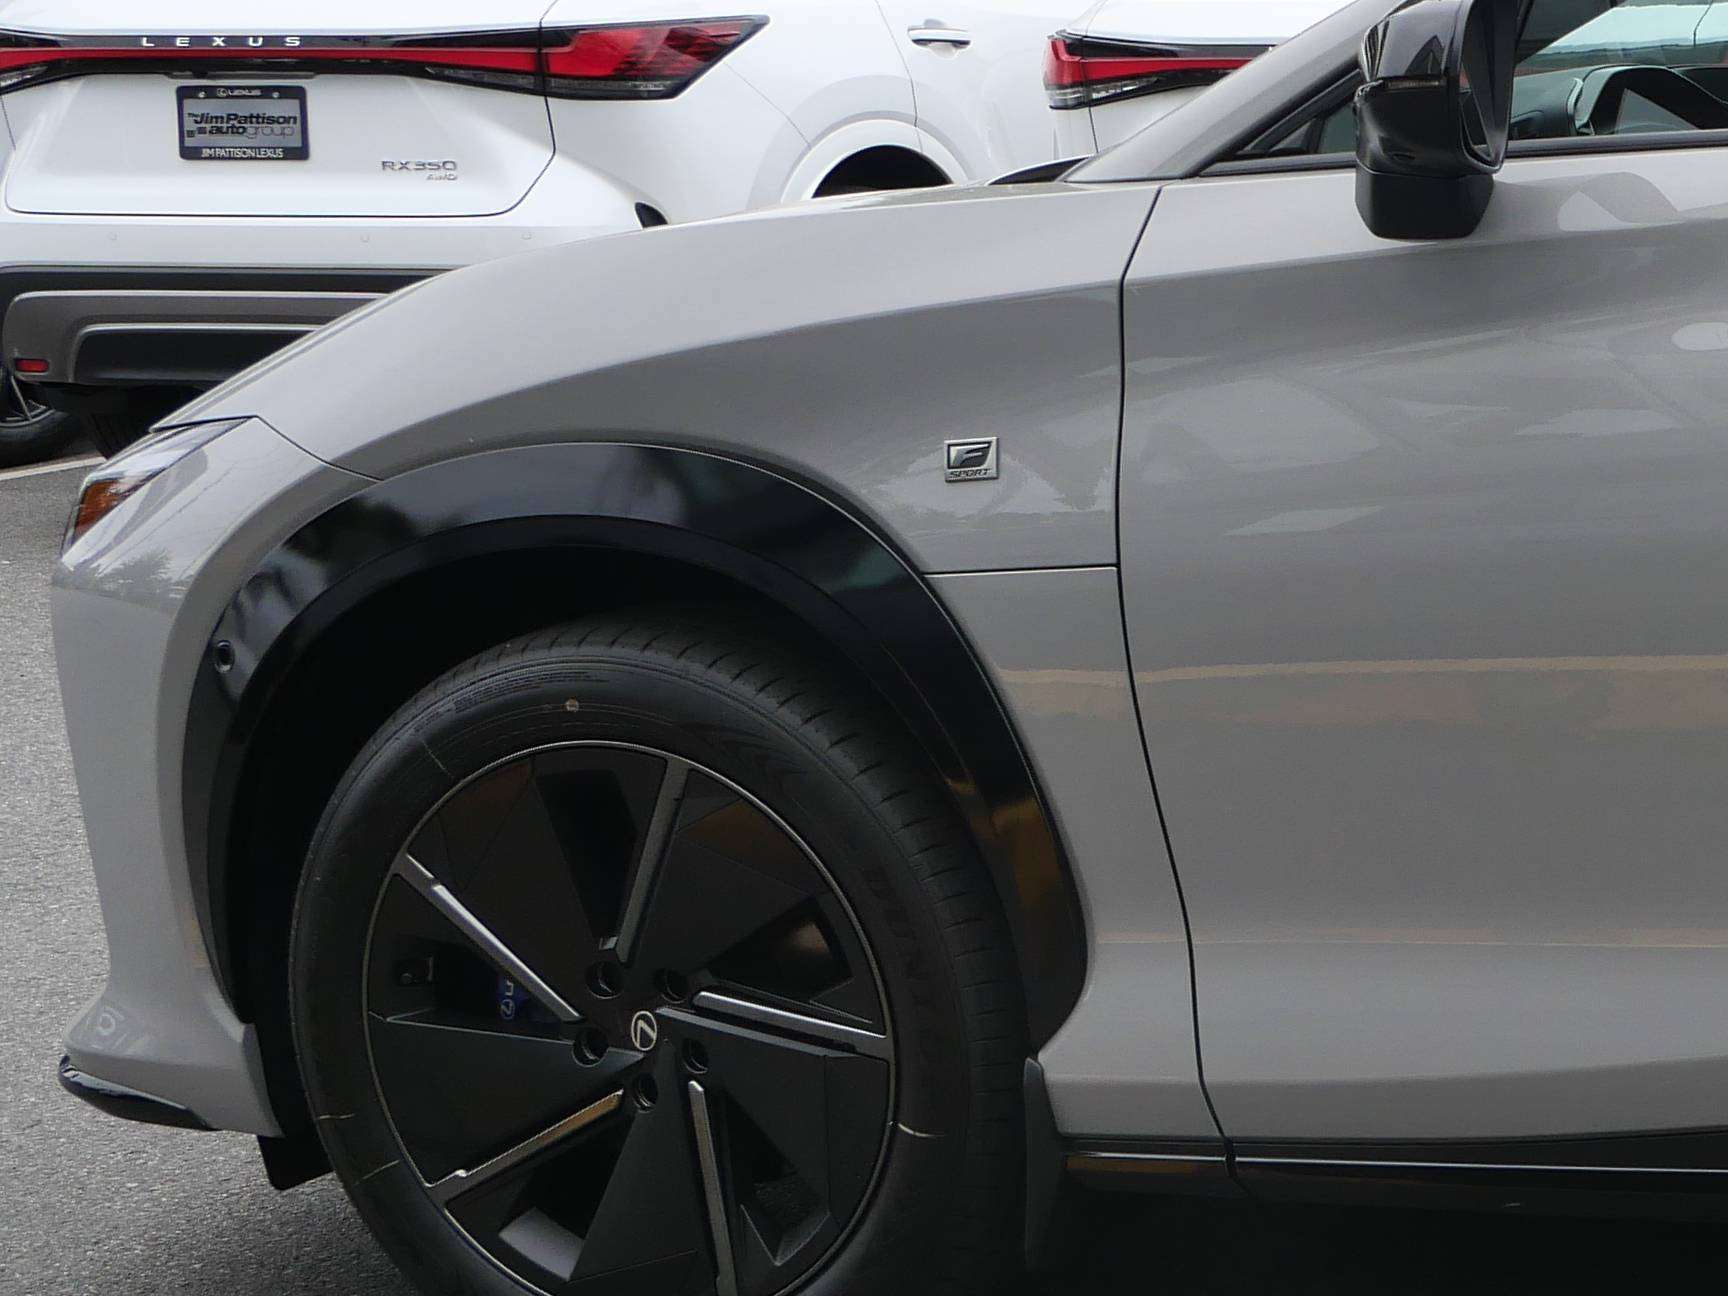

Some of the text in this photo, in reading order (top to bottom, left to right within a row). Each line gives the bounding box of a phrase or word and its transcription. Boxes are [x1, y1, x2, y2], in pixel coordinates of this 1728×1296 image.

[142, 36, 301, 47] LEXUS
[201, 148, 284, 158] JIM PATTISON LEXUS
[949, 468, 991, 478] SPORT
